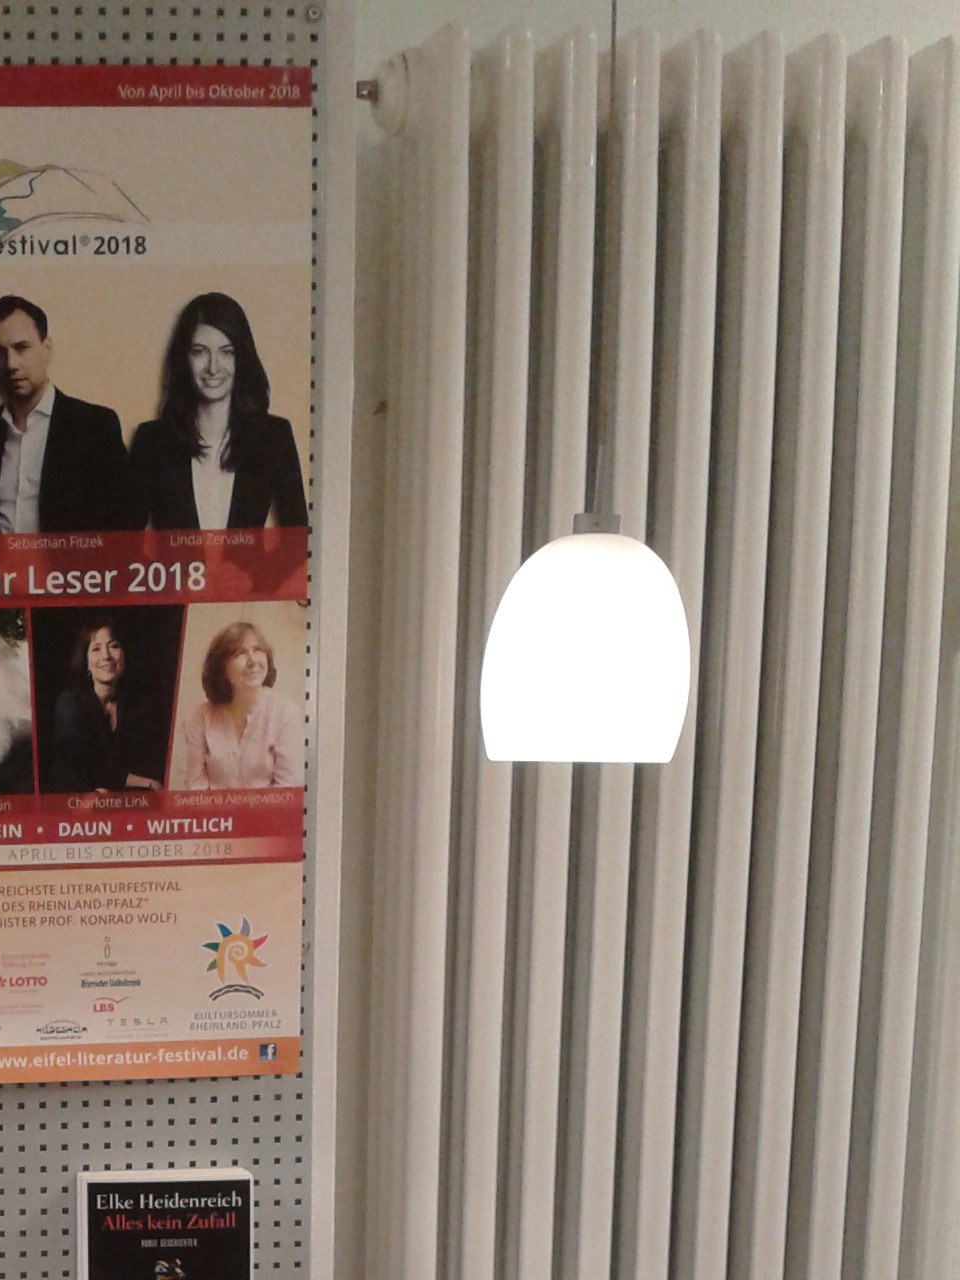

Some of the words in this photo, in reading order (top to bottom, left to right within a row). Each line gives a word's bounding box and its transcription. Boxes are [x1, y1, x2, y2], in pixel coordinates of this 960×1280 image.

[118, 85, 145, 98] Von
[148, 84, 181, 102] April
[185, 84, 205, 98] bis
[209, 84, 264, 98] Oktober
[267, 83, 300, 98] 2018
[93, 236, 147, 255] 2018
[8, 537, 66, 549] Sebastian
[69, 536, 103, 548] Fitzek
[170, 534, 202, 545] Linda
[206, 533, 254, 545] Zervakis
[28, 565, 117, 594] Leser
[127, 562, 206, 592] 2018
[68, 797, 122, 810] Charlotte
[125, 795, 149, 807] Link
[173, 793, 223, 806] Swetlana
[58, 822, 112, 837] DAUN
[147, 817, 232, 834] WITTLICH
[8, 847, 57, 861] APRIL
[66, 846, 92, 860] BIS
[102, 844, 184, 859] OKTOBER
[192, 842, 233, 856] 2018
[60, 881, 181, 895] LITERATURFESTIVAL
[40, 914, 76, 928] PROF.
[80, 913, 133, 926] KONRAD
[137, 911, 178, 925] WOLF)
[9, 976, 48, 987] LOTTO
[93, 1003, 115, 1013] LBS
[194, 1010, 278, 1021] KULTURSOMMER
[190, 1019, 281, 1031] RHEINLAND-PFALZ
[96, 1194, 134, 1210] Elke
[140, 1190, 242, 1209] Heidenreich
[101, 1214, 143, 1231] Alles
[147, 1213, 182, 1230] kein
[186, 1212, 236, 1229] Zufall
